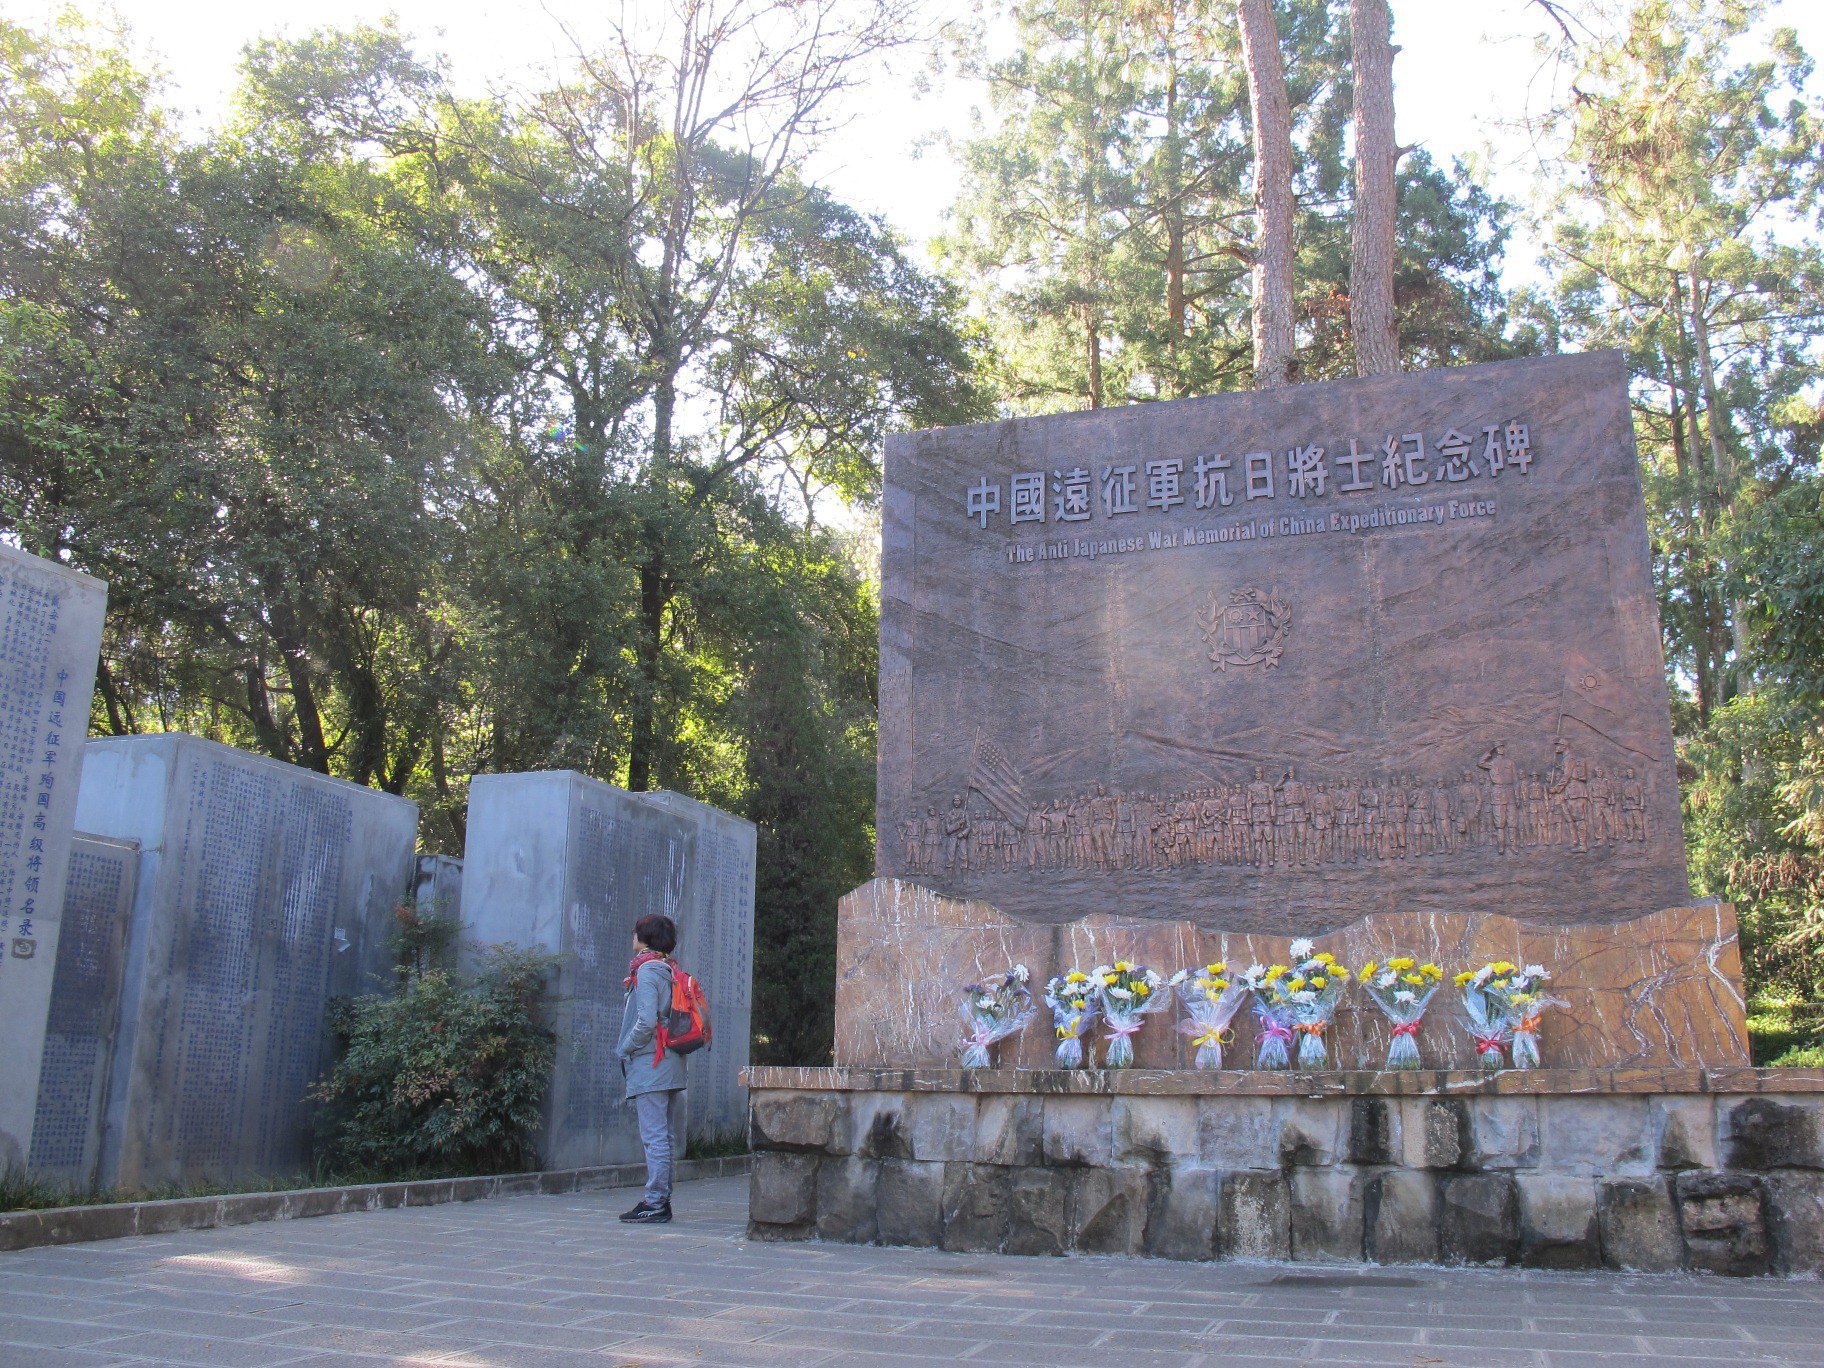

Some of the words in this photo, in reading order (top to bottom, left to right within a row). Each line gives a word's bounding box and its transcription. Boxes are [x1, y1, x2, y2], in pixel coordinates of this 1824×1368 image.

[966, 419, 1533, 530] 中國遠征軍抗日將士紀念碑
[1005, 544, 1035, 564] The
[1038, 540, 1069, 561] Anti
[1072, 536, 1145, 561] Japanese
[1148, 530, 1179, 550] War
[1183, 520, 1256, 547] Memorial
[1259, 517, 1275, 539] of
[1279, 513, 1326, 537] China
[1330, 502, 1445, 534] Expeditionary
[1448, 498, 1497, 520] Force
[18, 668, 69, 937] 中国远征军殉国高级将领名录
